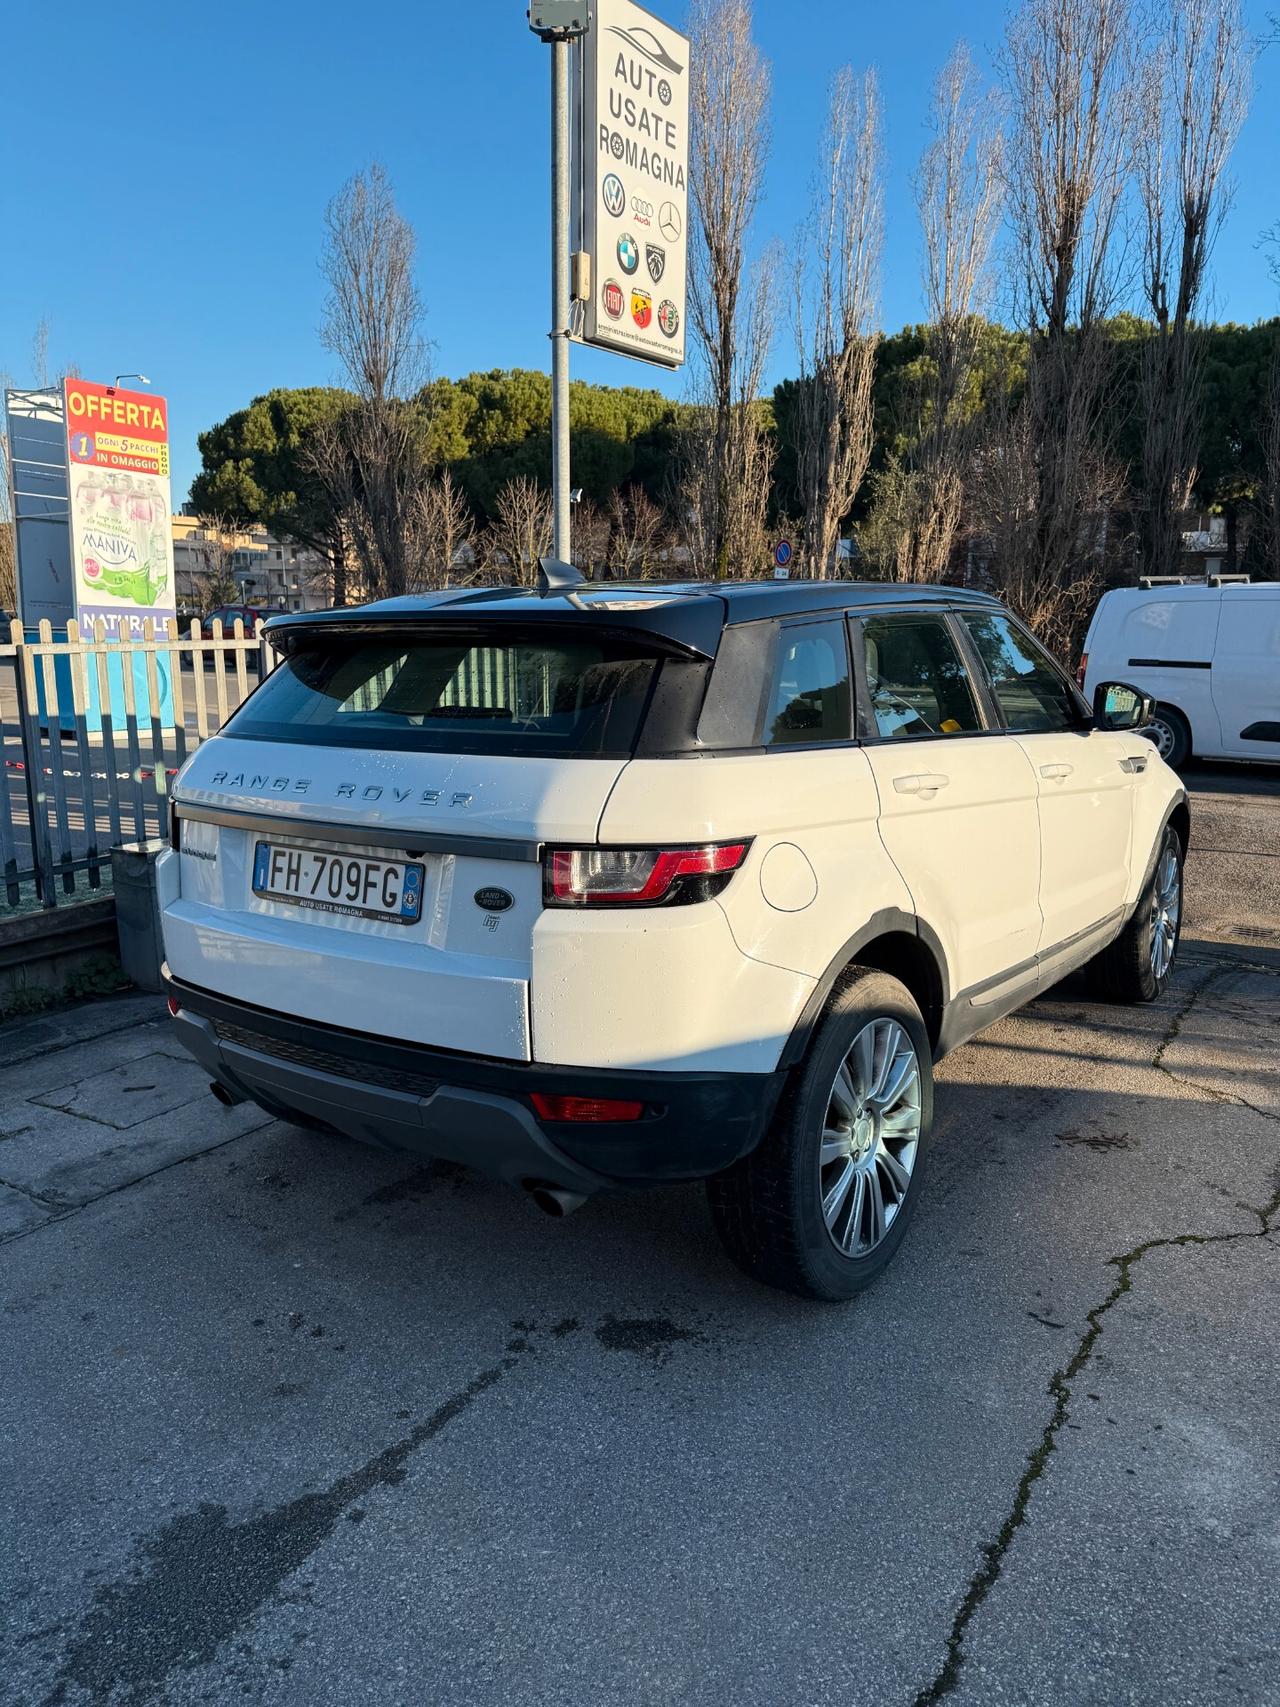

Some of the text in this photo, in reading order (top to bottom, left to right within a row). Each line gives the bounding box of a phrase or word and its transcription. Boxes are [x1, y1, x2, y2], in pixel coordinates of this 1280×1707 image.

[614, 51, 672, 107] AUTO
[609, 87, 677, 150] USATE
[600, 123, 685, 191] ROMAGNA
[633, 213, 651, 227] Audi
[607, 289, 622, 312] FIAT
[68, 391, 165, 431] OFFERTA
[78, 436, 88, 456] 1
[97, 436, 159, 454] OGNI 5 PACCHI
[96, 453, 159, 470] IN OMAGGIO
[160, 444, 168, 474] PROMO
[83, 533, 137, 562] MANIVA
[209, 770, 473, 809] RANGE ROVER
[299, 899, 314, 908] AUTO
[315, 902, 333, 912] USATE
[334, 906, 363, 917] ROMAGNA
[480, 891, 500, 899] LAND
